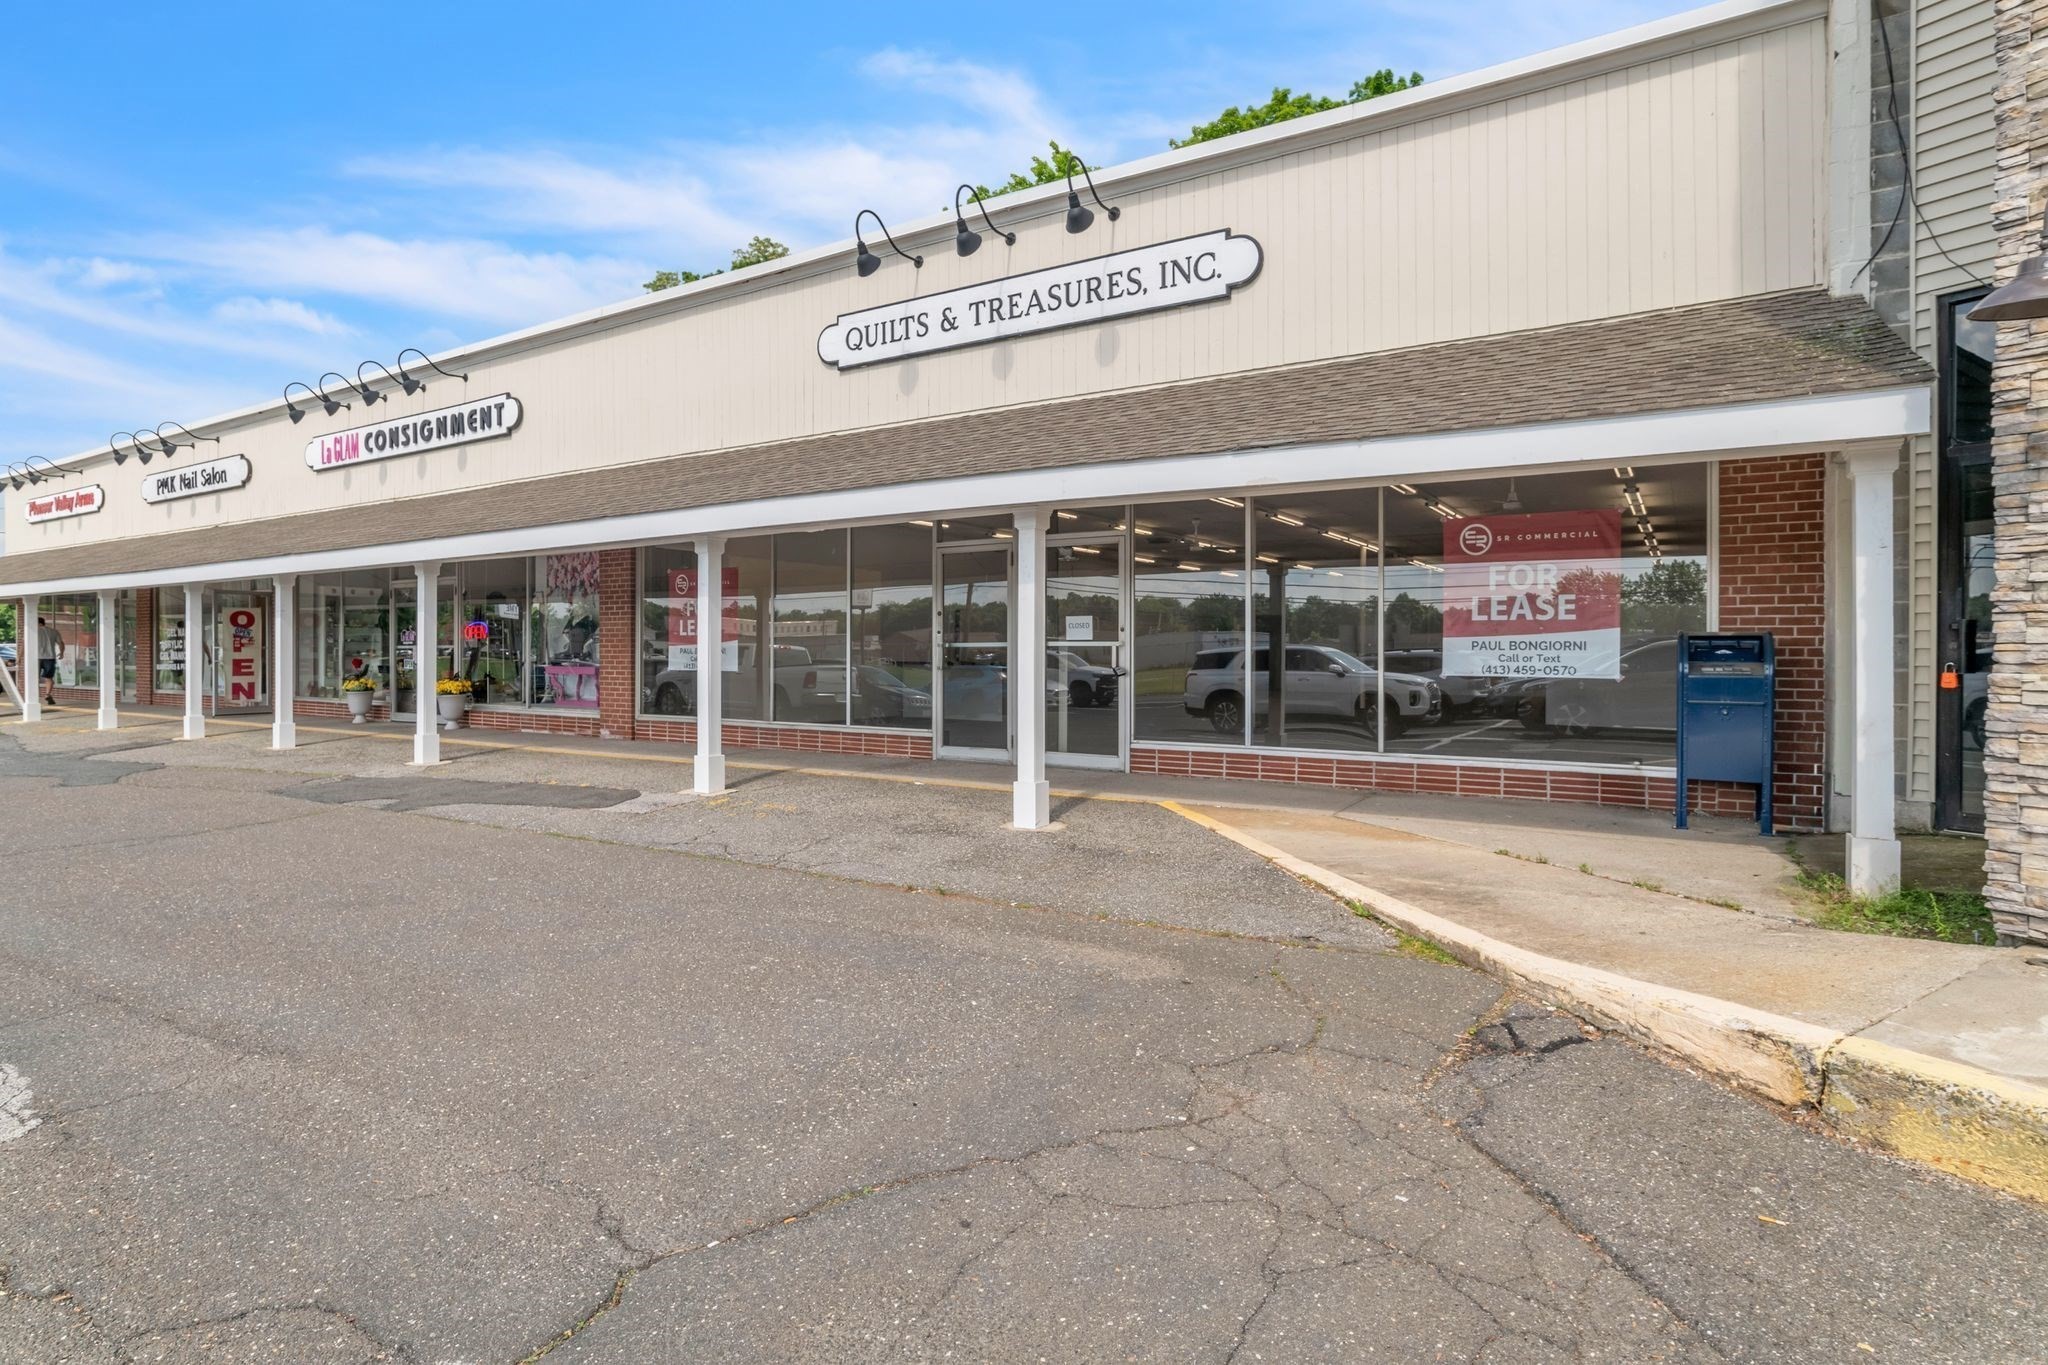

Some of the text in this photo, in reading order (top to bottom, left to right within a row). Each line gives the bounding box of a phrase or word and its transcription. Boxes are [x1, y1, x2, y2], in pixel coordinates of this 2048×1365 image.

[845, 251, 1223, 352] QUILTS & TREASURES, INC.
[321, 402, 505, 465] La GLAM CONSIGNMENT
[157, 466, 227, 496] PMK Nail Salon
[1517, 531, 1598, 541] COMMERCIAL
[1488, 563, 1559, 591] FOR
[1471, 594, 1577, 621] LEASE
[464, 625, 488, 640] OPEN
[1471, 640, 1587, 651] PAUL BONGIORNI
[229, 610, 255, 701] OPEN
[1498, 653, 1561, 663] Call or Text
[1481, 664, 1577, 676] (413) 459-0570
